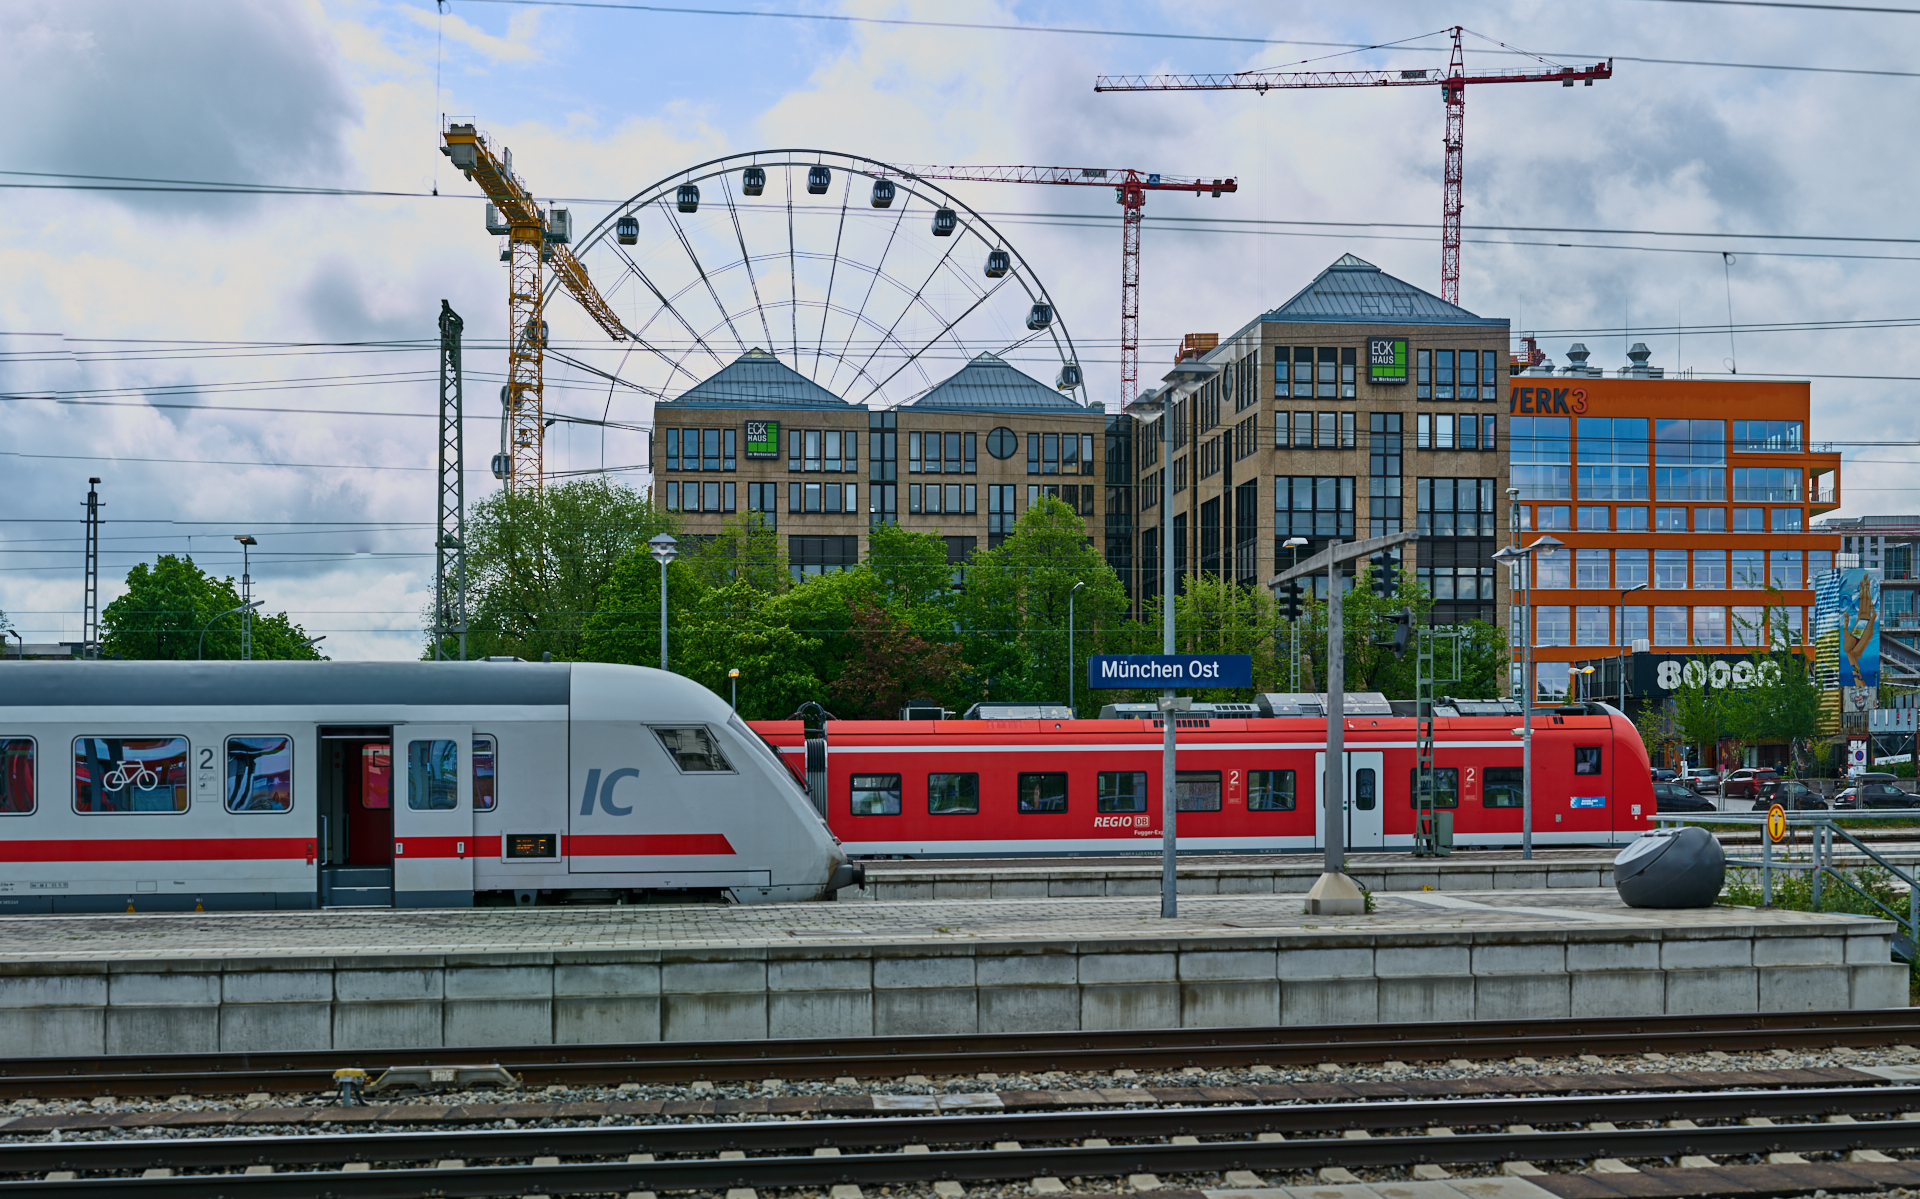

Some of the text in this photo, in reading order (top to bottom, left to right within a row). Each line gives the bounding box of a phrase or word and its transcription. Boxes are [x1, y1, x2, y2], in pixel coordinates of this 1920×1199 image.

[1371, 341, 1394, 355] ECK
[1371, 355, 1394, 364] HAUS
[747, 422, 767, 435] ECK
[1101, 660, 1220, 679] München Ost
[199, 748, 214, 770] 2
[1230, 770, 1239, 784] 2
[1466, 767, 1475, 781] 2
[580, 767, 640, 817] IC
[1093, 816, 1149, 828] REGIO DB
